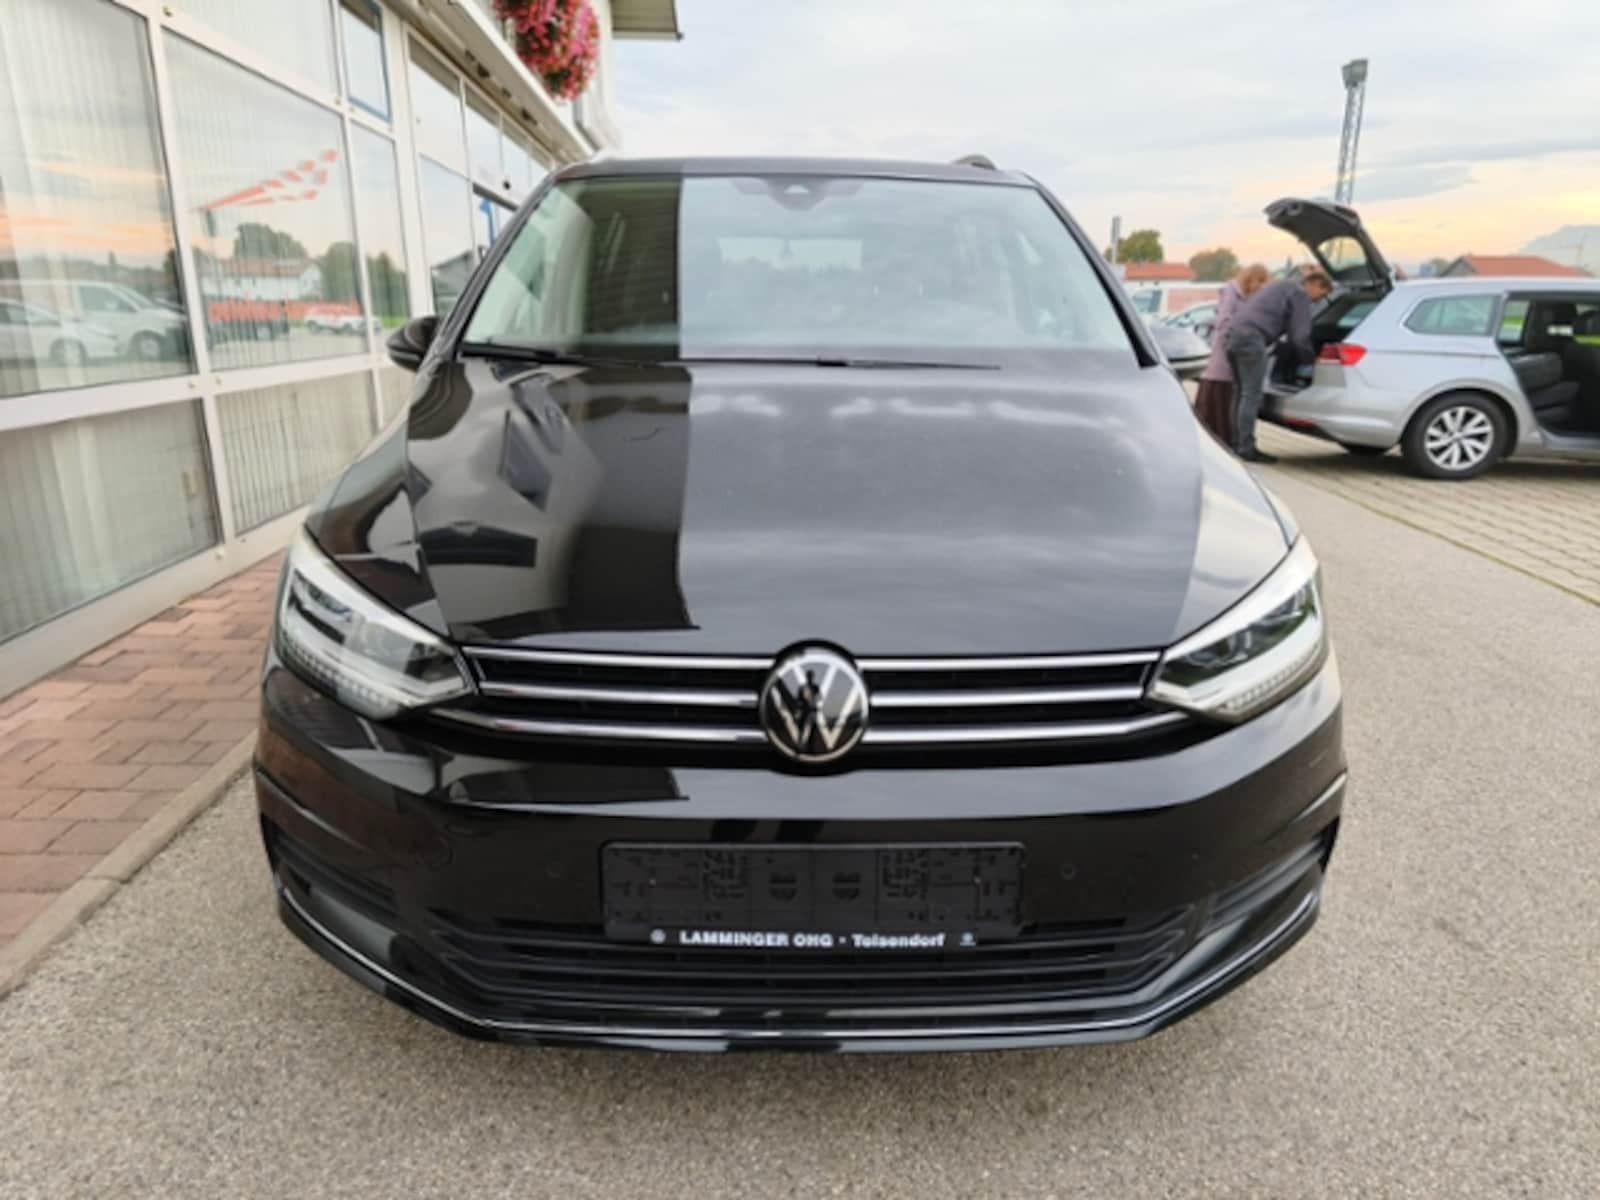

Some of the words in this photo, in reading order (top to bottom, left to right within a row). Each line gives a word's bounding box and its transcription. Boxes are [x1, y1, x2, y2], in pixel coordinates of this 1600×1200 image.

[679, 929, 789, 947] LAMMINGER
[793, 931, 834, 948] OHG
[851, 931, 947, 948] Teisendorf
